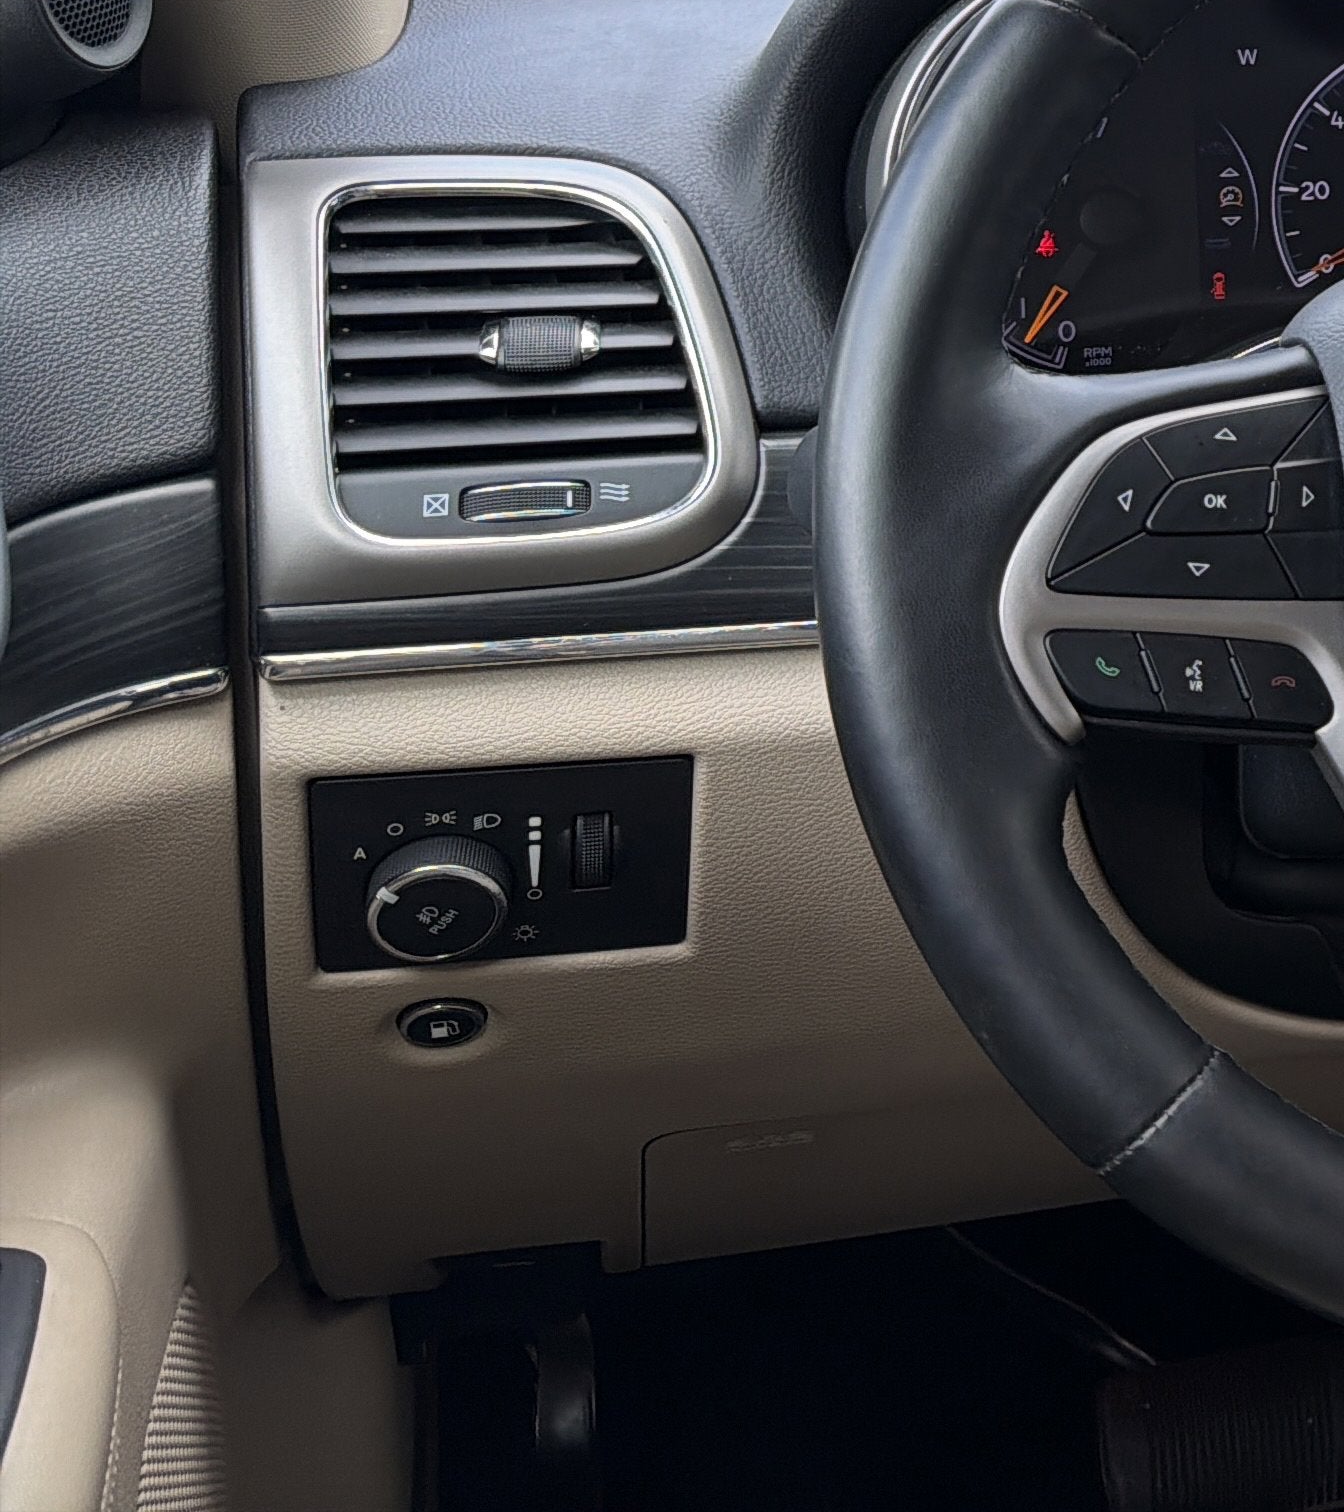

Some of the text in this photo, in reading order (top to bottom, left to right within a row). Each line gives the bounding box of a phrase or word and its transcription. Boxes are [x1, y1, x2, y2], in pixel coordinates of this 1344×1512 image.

[1237, 48, 1258, 66] W
[1300, 180, 1331, 201] 20
[1058, 320, 1076, 343] 0
[1083, 346, 1113, 358] RPM
[1203, 492, 1228, 510] OK
[1188, 678, 1203, 692] VR
[353, 847, 367, 861] A
[428, 908, 459, 936] PUSH
